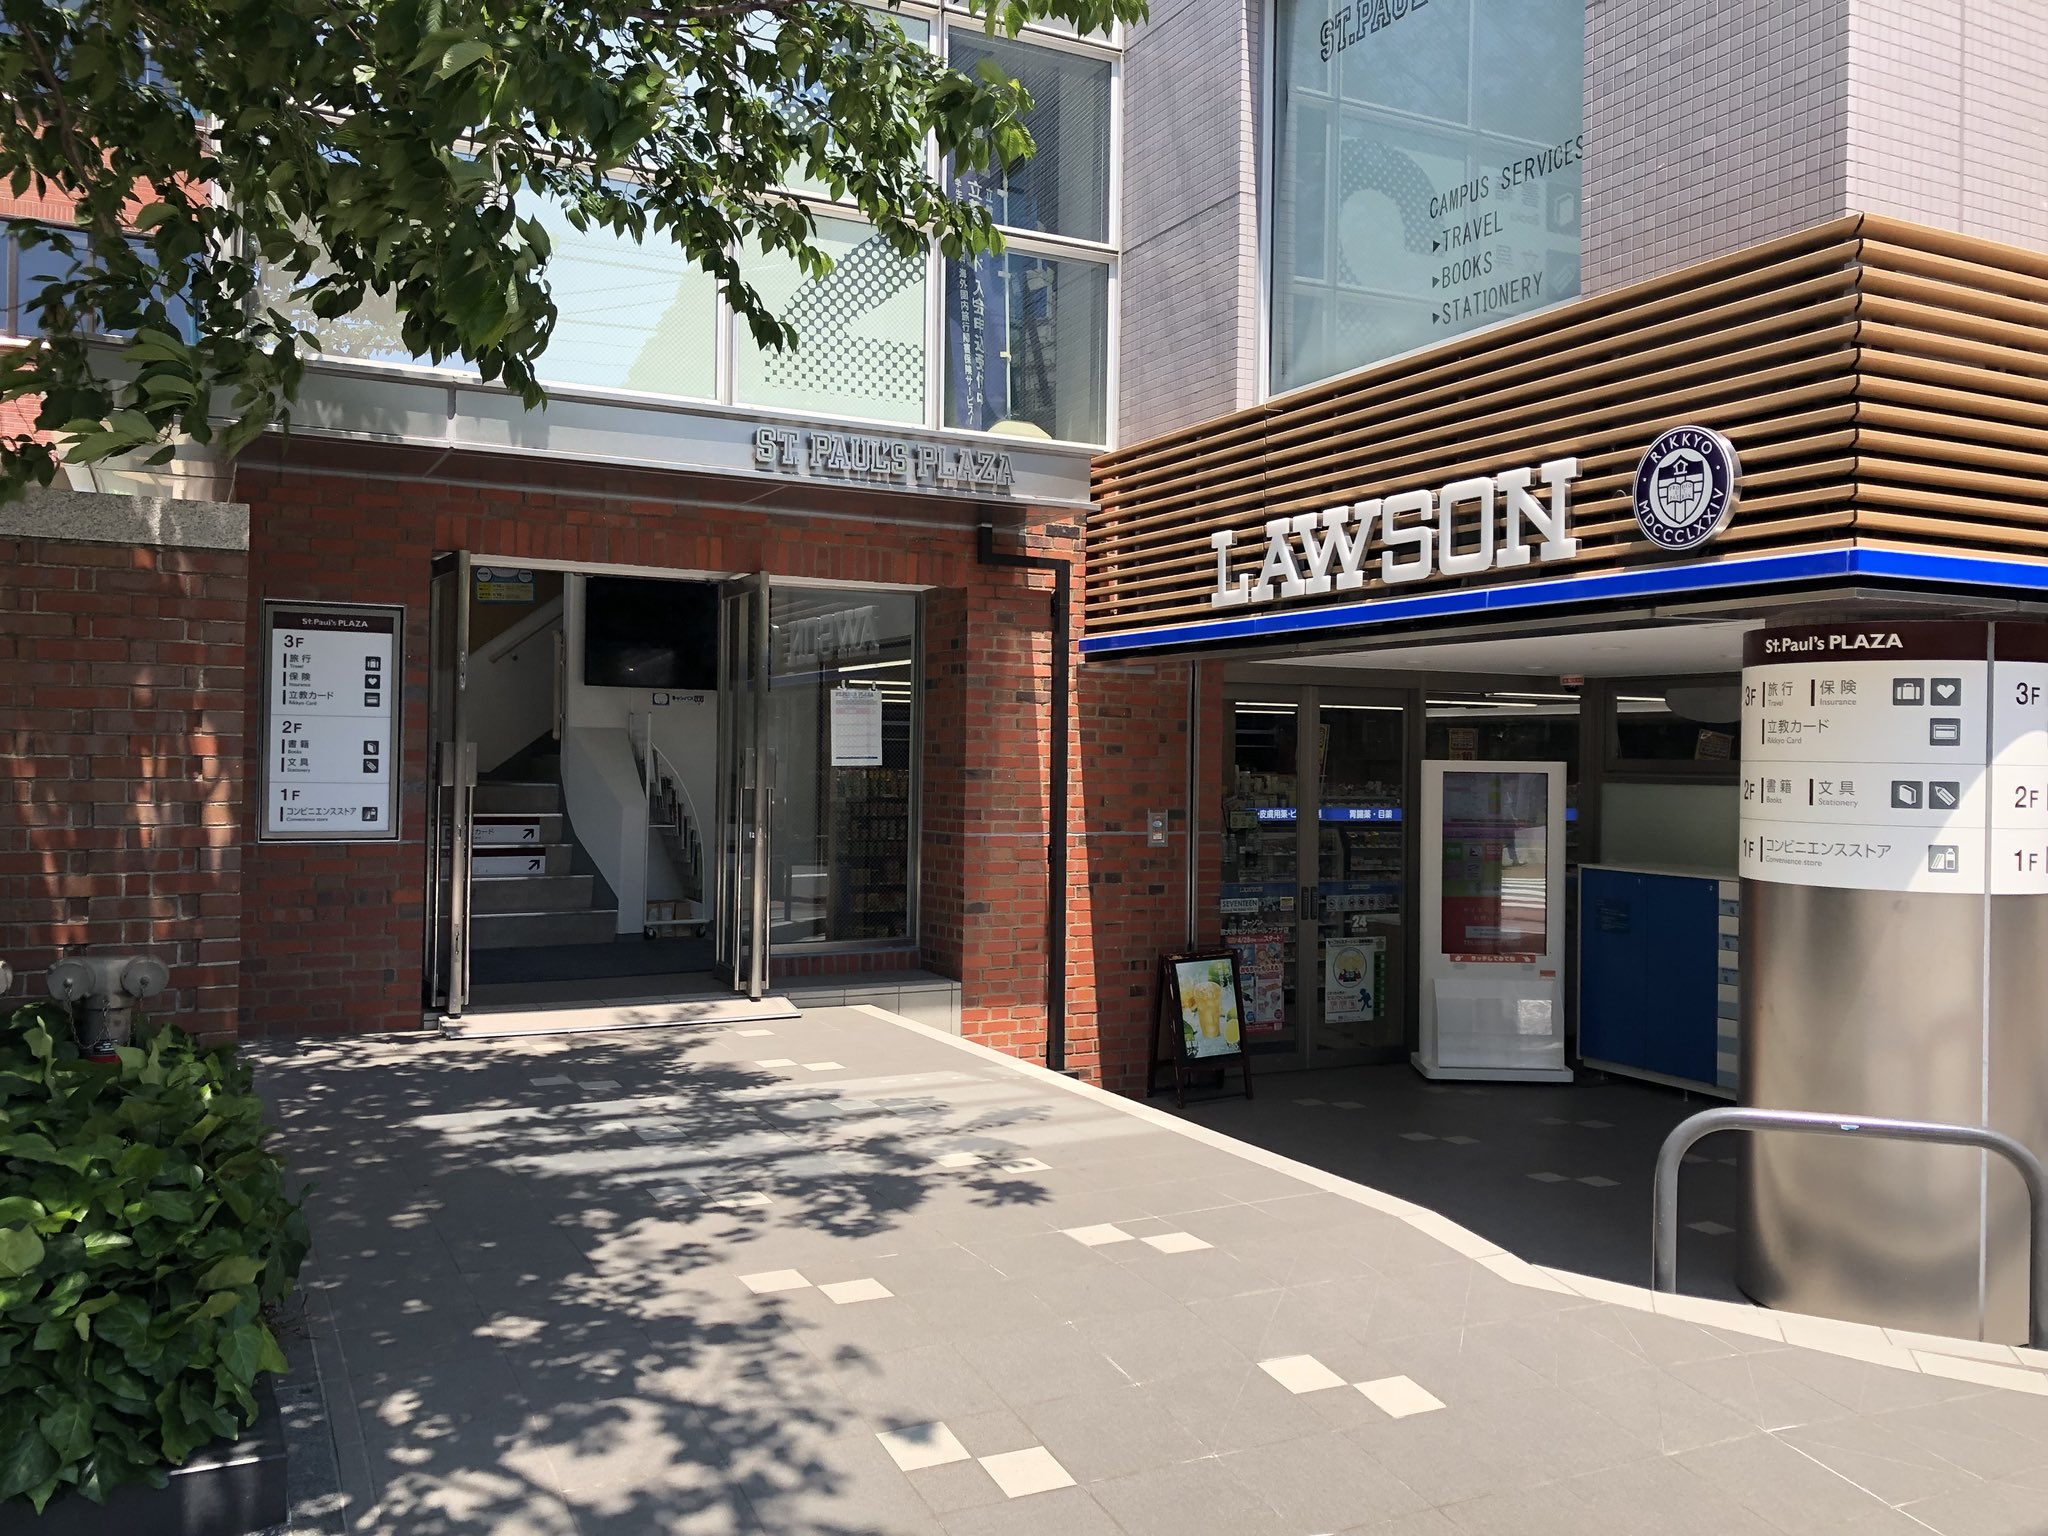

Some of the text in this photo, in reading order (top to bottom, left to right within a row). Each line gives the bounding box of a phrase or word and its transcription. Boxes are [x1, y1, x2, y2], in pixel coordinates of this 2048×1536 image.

[1320, 0, 1429, 62] ST.PA
[1429, 135, 1583, 219] CAMPUS SERVICES
[1443, 211, 1503, 252] TRAVEL
[1442, 251, 1492, 289] BOOKS
[1442, 271, 1543, 325] STATIONERY
[755, 426, 1016, 485] ST. PAUL'S PLAZA
[1650, 433, 1713, 463] RIKKYO
[1639, 487, 1724, 543] MDCCCLXXIV
[1211, 457, 1581, 608] LAWSON
[338, 619, 369, 628] PLAZA
[284, 634, 304, 648] 3F
[1765, 633, 1903, 653] St.Paul's PLAZA
[289, 654, 311, 663] 旅行
[289, 672, 311, 681] 保険
[1768, 681, 1793, 697] 旅行
[1820, 679, 1857, 695] 保険
[2015, 682, 2041, 706] 3F
[289, 691, 334, 700] 立教カード
[1745, 685, 1757, 706] 3F
[1768, 699, 1783, 707] Travel
[1820, 698, 1857, 706] Insurance
[282, 721, 302, 734] 2F
[1768, 719, 1830, 734] 立教カード
[288, 740, 309, 748] 書籍
[1767, 737, 1785, 745] Rikkyo
[287, 758, 309, 767] 文具
[1743, 779, 1755, 801] 2F
[1766, 778, 1792, 794] 書籍
[1818, 780, 1855, 796] 文具
[281, 788, 300, 801] 1F
[1766, 796, 1782, 804] Books
[2014, 785, 2039, 809] 2F
[287, 807, 357, 816] コンビニエンスストア
[1818, 798, 1859, 809] Stationery
[1743, 837, 1755, 858] 1F
[1766, 839, 1892, 859] コンビニエンスストア
[1765, 855, 1823, 867] Convenience store
[2013, 849, 2039, 872] 1F
[1222, 899, 1258, 907] SEVENTEEN
[1351, 914, 1368, 927] 24
